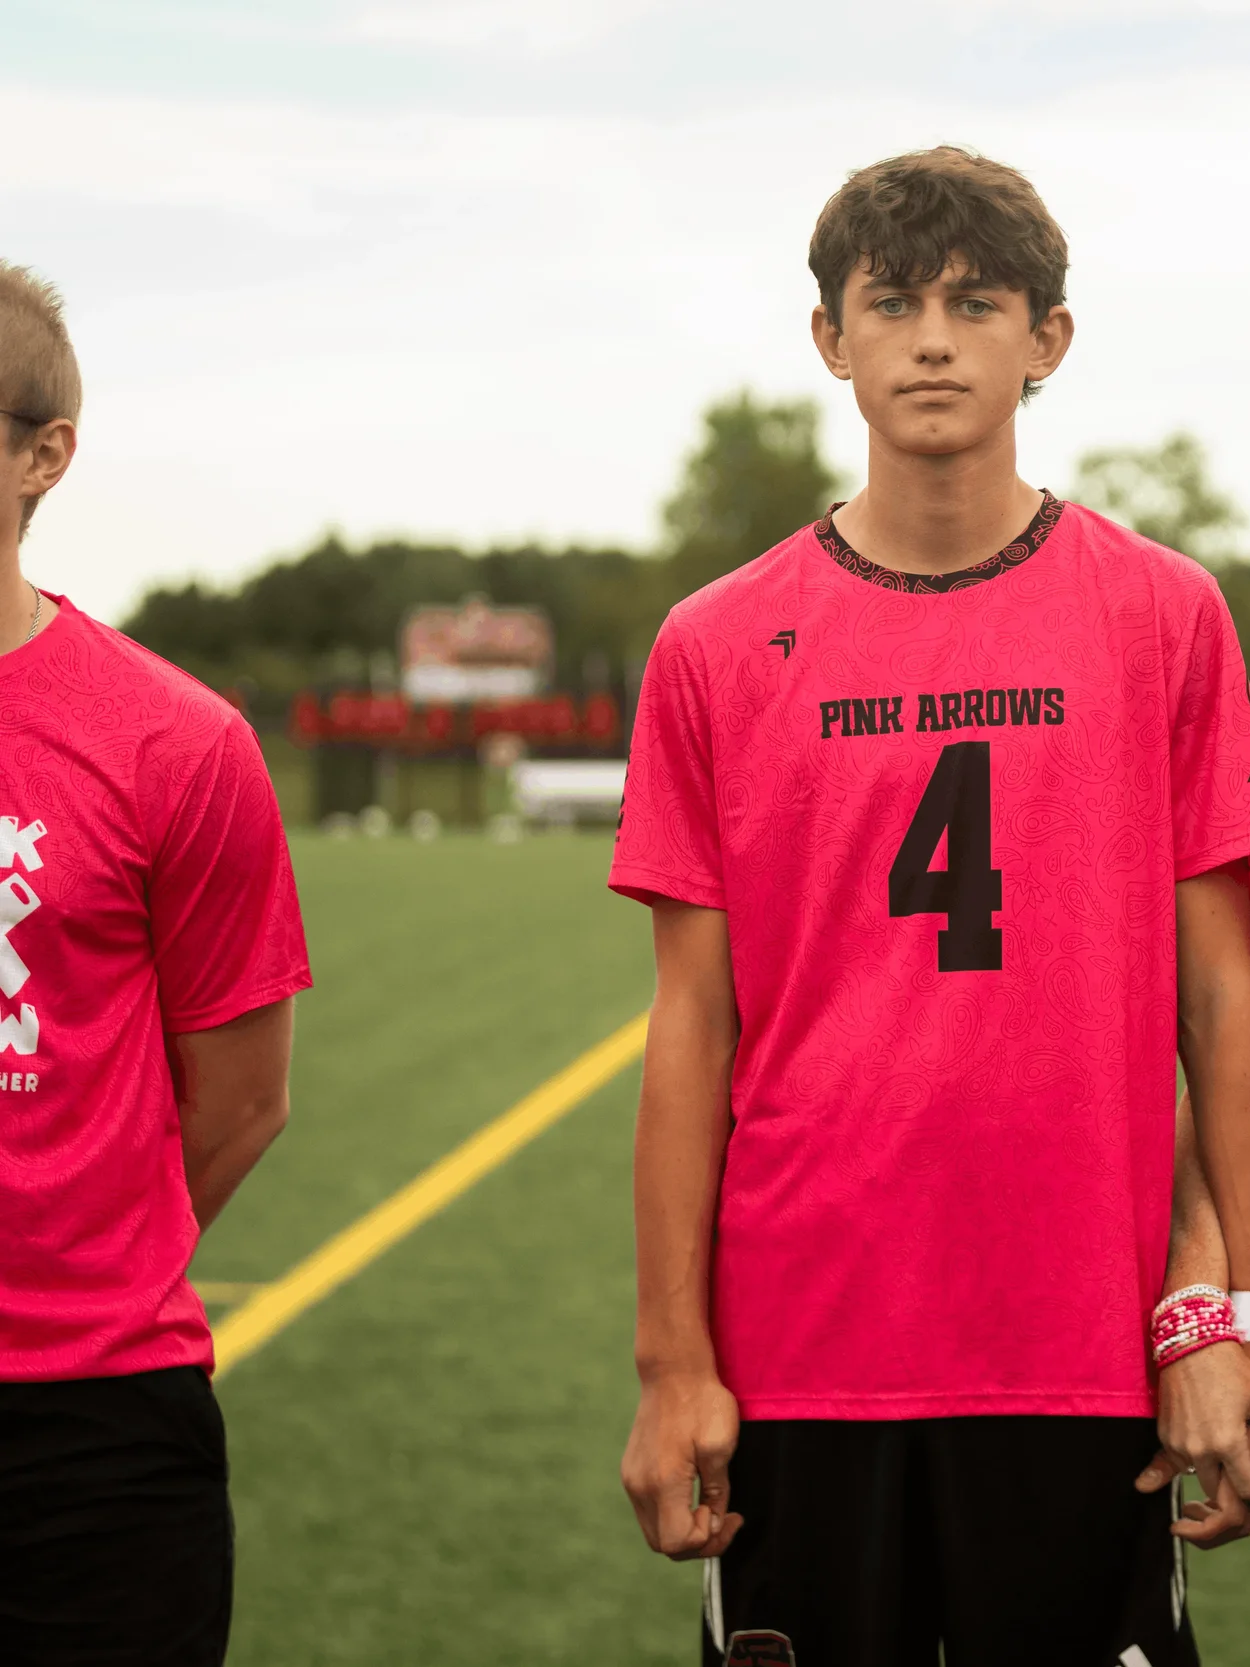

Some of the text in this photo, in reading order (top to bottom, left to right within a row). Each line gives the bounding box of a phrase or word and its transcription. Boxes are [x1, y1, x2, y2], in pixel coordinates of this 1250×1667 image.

[819, 687, 1065, 739] PINK ARROWS
[888, 740, 1003, 973] 4
